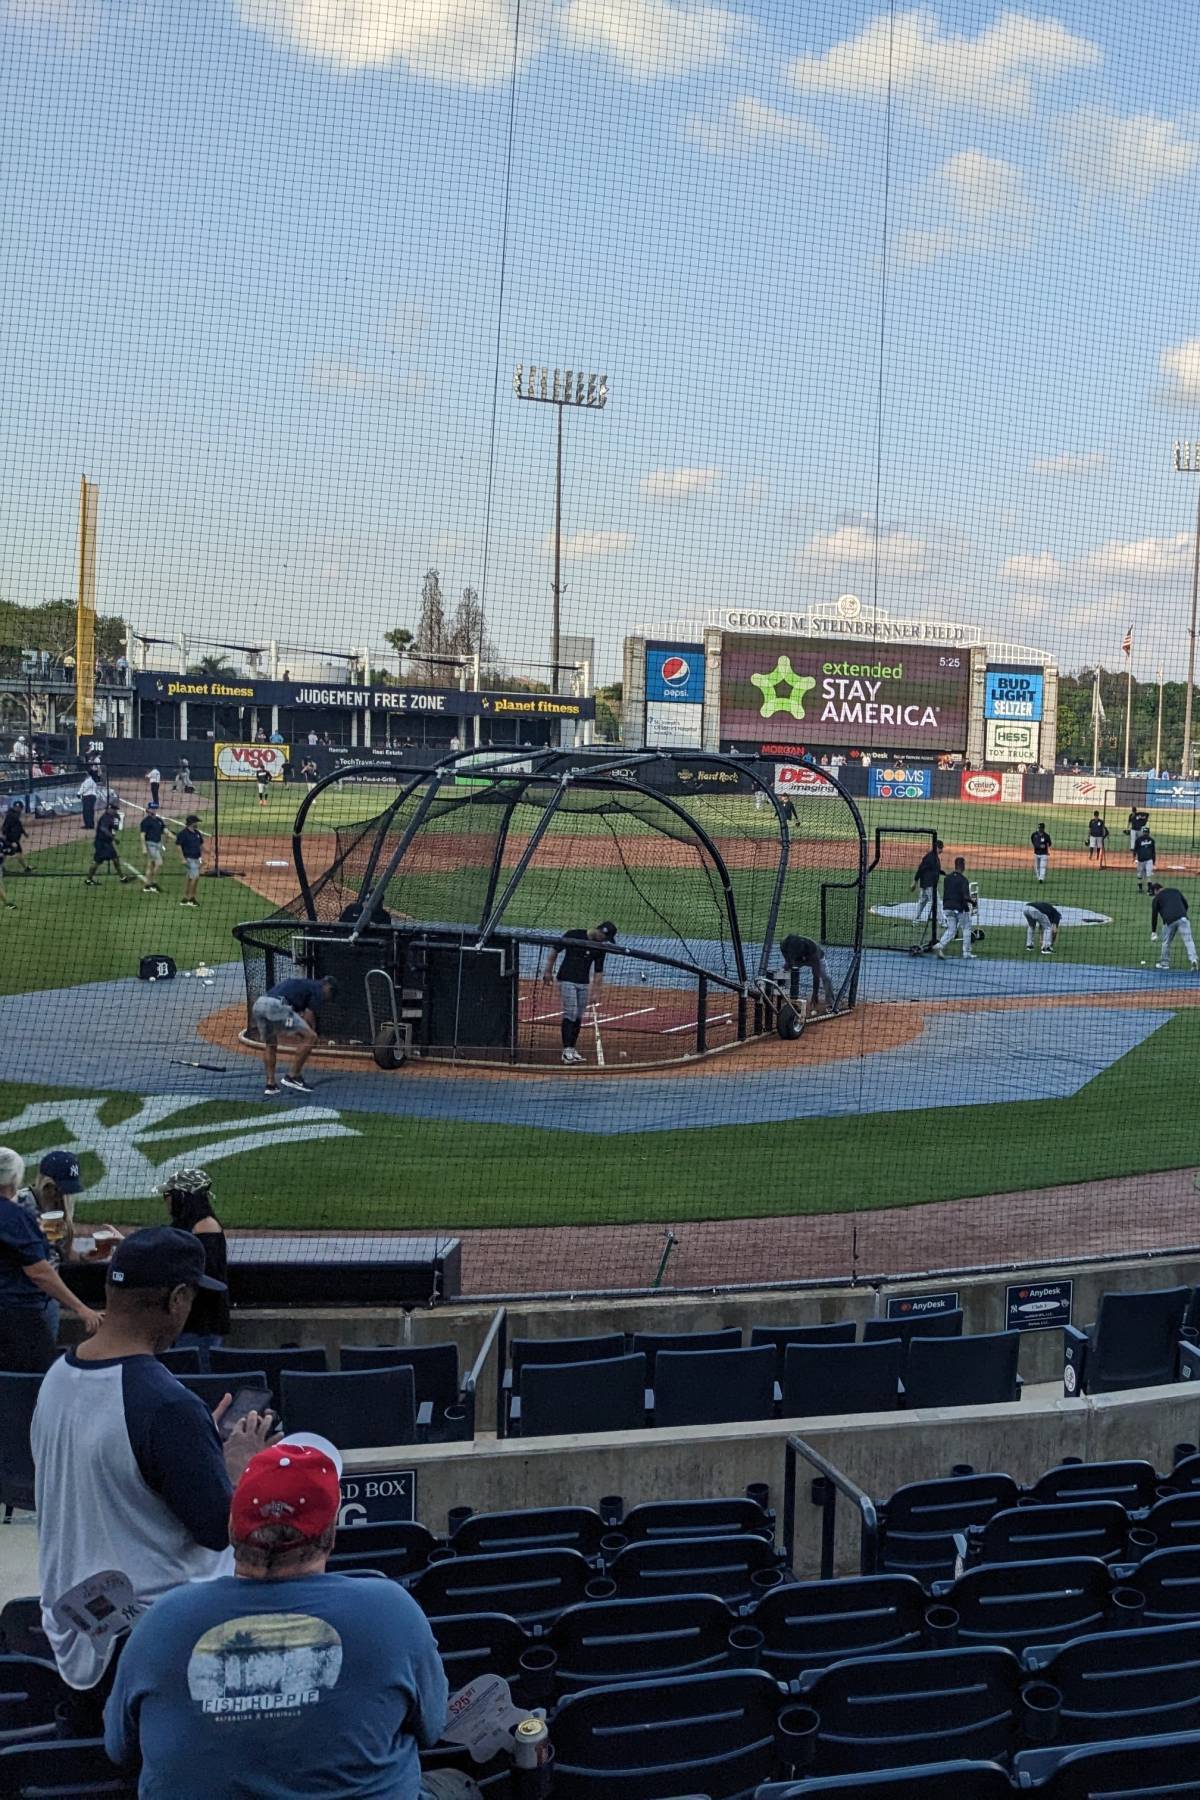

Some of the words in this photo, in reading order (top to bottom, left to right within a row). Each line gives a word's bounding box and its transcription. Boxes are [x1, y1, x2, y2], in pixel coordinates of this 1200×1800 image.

[728, 613, 786, 628] GEORGE
[812, 618, 921, 640] STEINBRENNER
[924, 625, 964, 641] FIELD
[939, 657, 960, 668] 5:25
[823, 661, 902, 679] extended
[168, 681, 208, 696] planet
[211, 683, 254, 697] fitness
[822, 678, 882, 701] STAY
[998, 678, 1031, 690] BUD
[295, 689, 371, 708] JUDGEMENT
[374, 693, 407, 708] FREE
[411, 695, 445, 711] ZONE
[991, 689, 1036, 702] LIGHT
[494, 699, 536, 713] planet
[537, 700, 580, 715] fitness
[994, 700, 1033, 717] SELTZER
[820, 701, 938, 727] AMERICA
[997, 732, 1028, 742] HESS
[761, 744, 805, 755] MORGAN
[989, 749, 1004, 757] TOY
[1008, 750, 1035, 758] TRUCK
[698, 770, 719, 780] Hard
[719, 771, 738, 783] Rock
[876, 768, 924, 782] ROOMS
[790, 784, 835, 793] imaging
[876, 785, 892, 797] TO
[894, 785, 918, 798] GO
[968, 780, 996, 791] Century
[1030, 1287, 1061, 1298] AnyDesk
[912, 1300, 946, 1311] AnyDesk
[366, 1480, 406, 1498] BOX
[339, 1503, 367, 1527] G
[204, 1698, 245, 1713] FISH
[251, 1690, 318, 1711] HIPPIE
